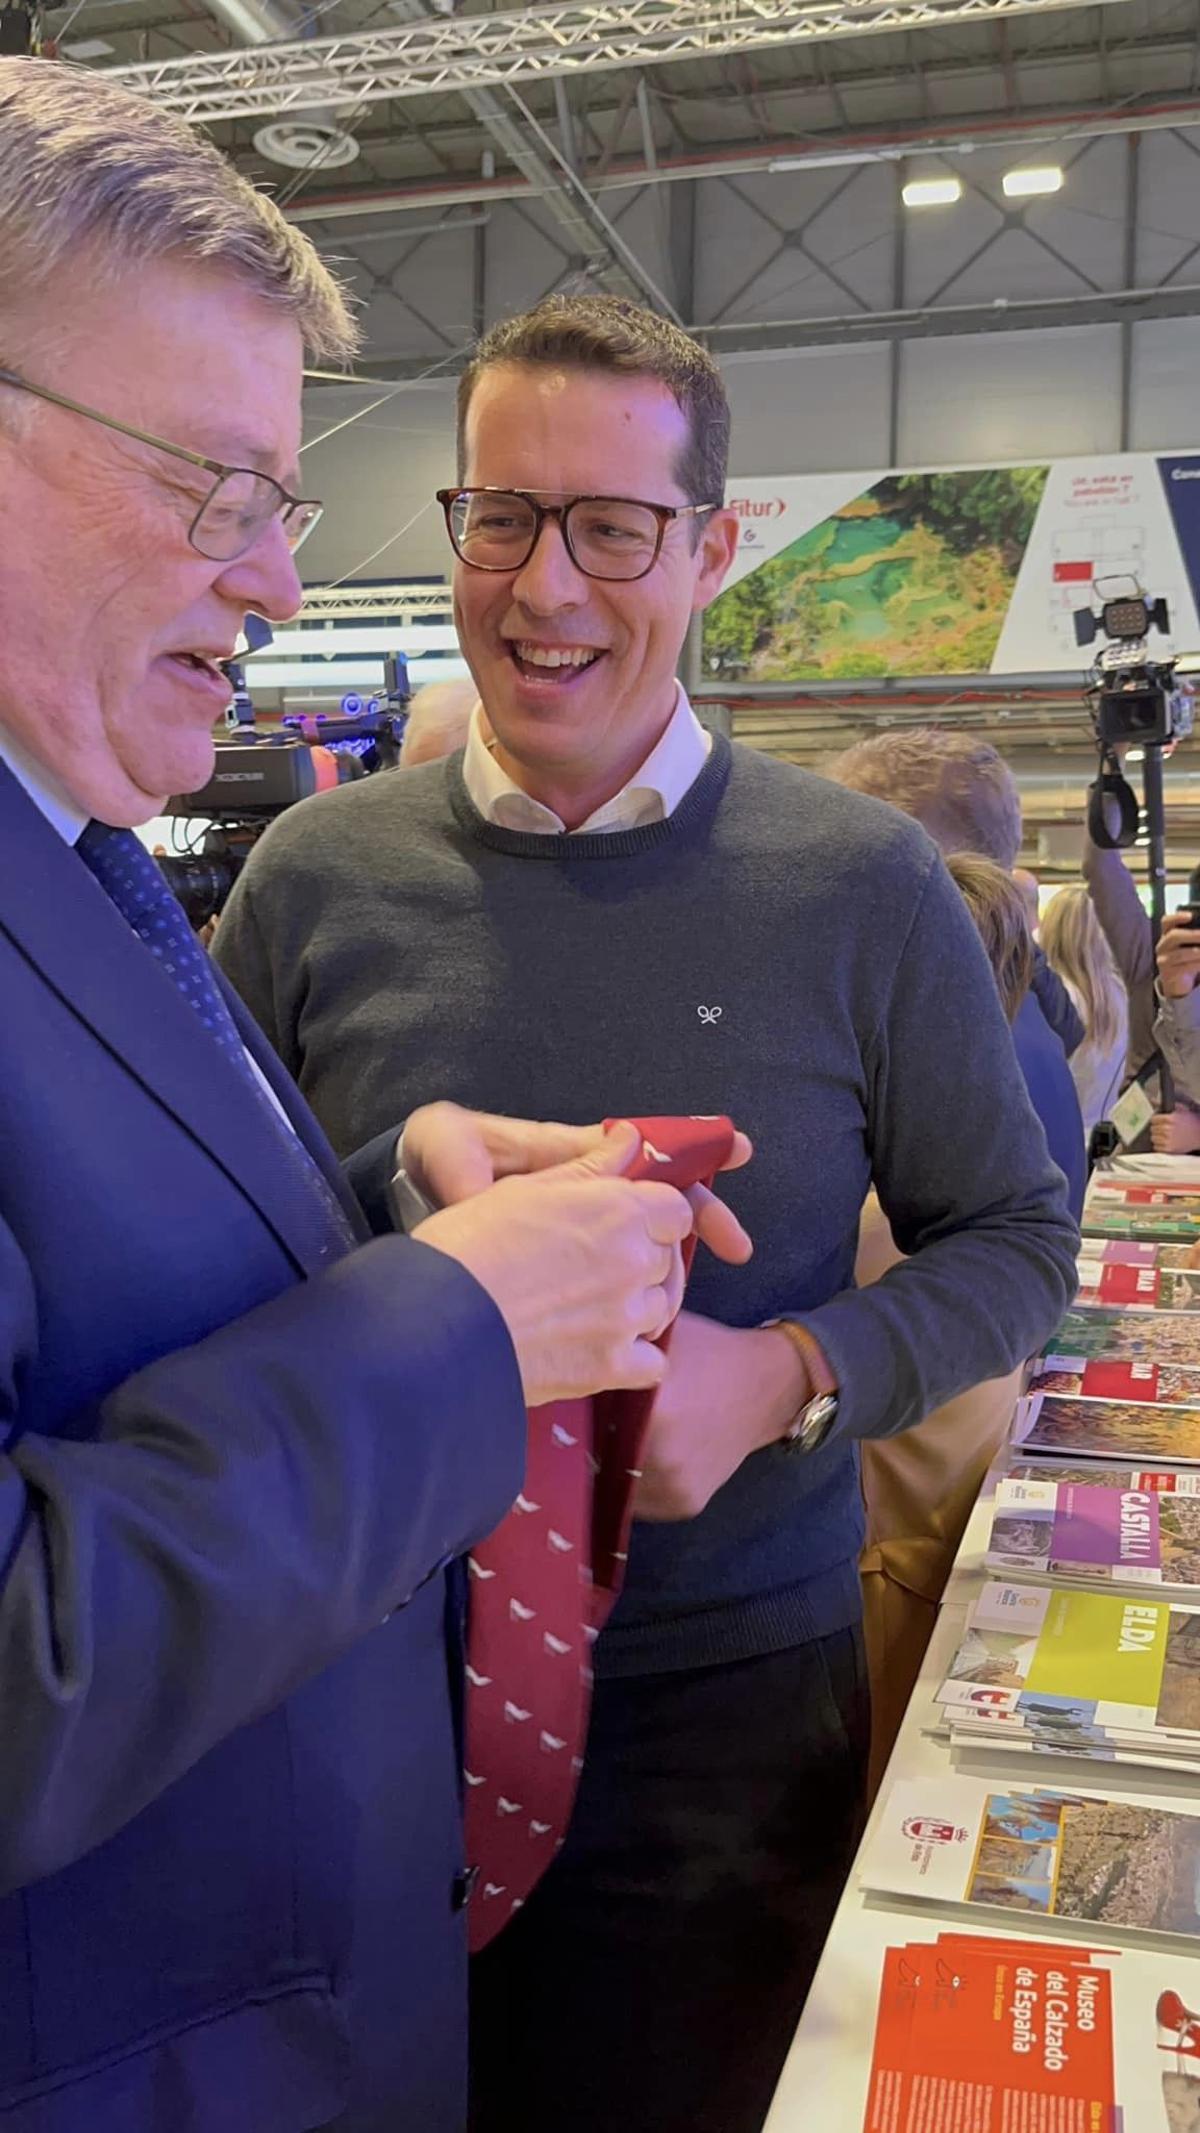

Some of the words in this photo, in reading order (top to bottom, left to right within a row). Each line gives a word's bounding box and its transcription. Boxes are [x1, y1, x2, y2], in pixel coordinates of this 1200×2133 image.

[1119, 1491, 1151, 1559] CASTALLA
[1117, 1604, 1158, 1653] ELDA
[1015, 1967, 1038, 1986] de
[1045, 1971, 1069, 1996] del
[1077, 1975, 1100, 2031] Museo
[1009, 1989, 1038, 2054] España
[1044, 1999, 1069, 2071] Calzado
